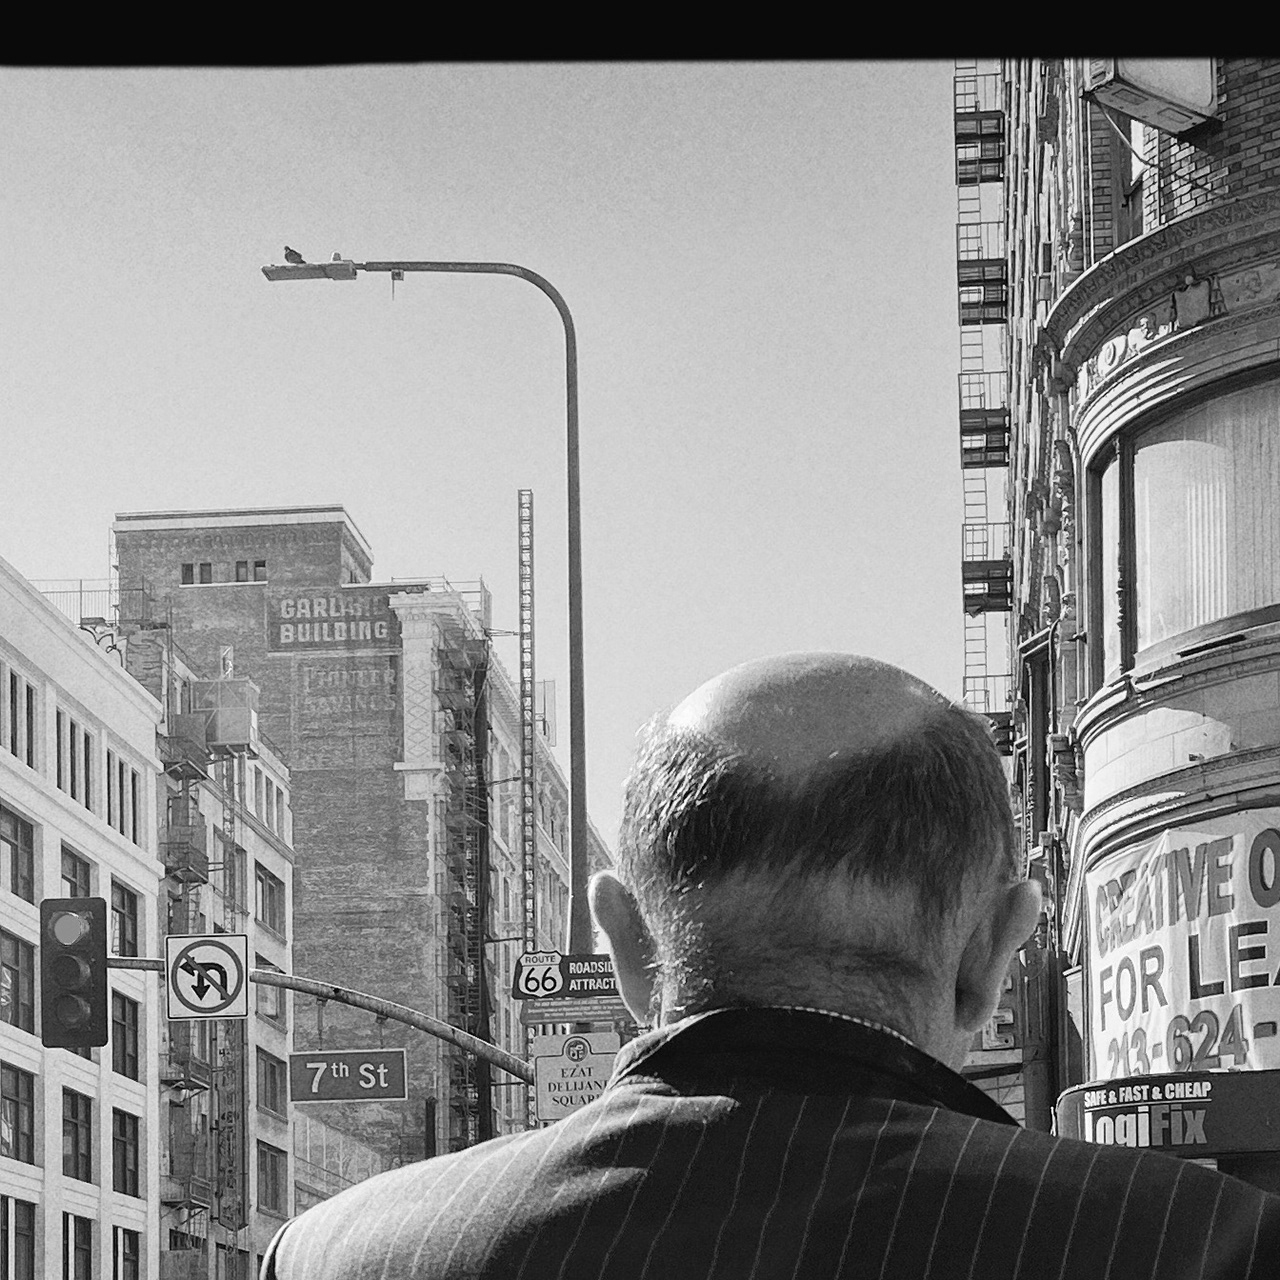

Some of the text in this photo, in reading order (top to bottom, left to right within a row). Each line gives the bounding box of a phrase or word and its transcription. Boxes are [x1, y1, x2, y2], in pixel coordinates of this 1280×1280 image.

[280, 621, 388, 643] BUILDING
[1096, 835, 1235, 958] CREATIVE
[525, 955, 556, 964] ROUTE
[569, 961, 614, 974] ROADSID
[524, 966, 557, 993] 66
[569, 977, 618, 991] ATTRACT
[1099, 944, 1168, 1031] FOR
[306, 1062, 388, 1092] 7th St
[561, 1067, 594, 1078] EZAT
[552, 1096, 599, 1106] SQUAR
[1084, 1081, 1212, 1108] SAFE & FAST & CHEAP
